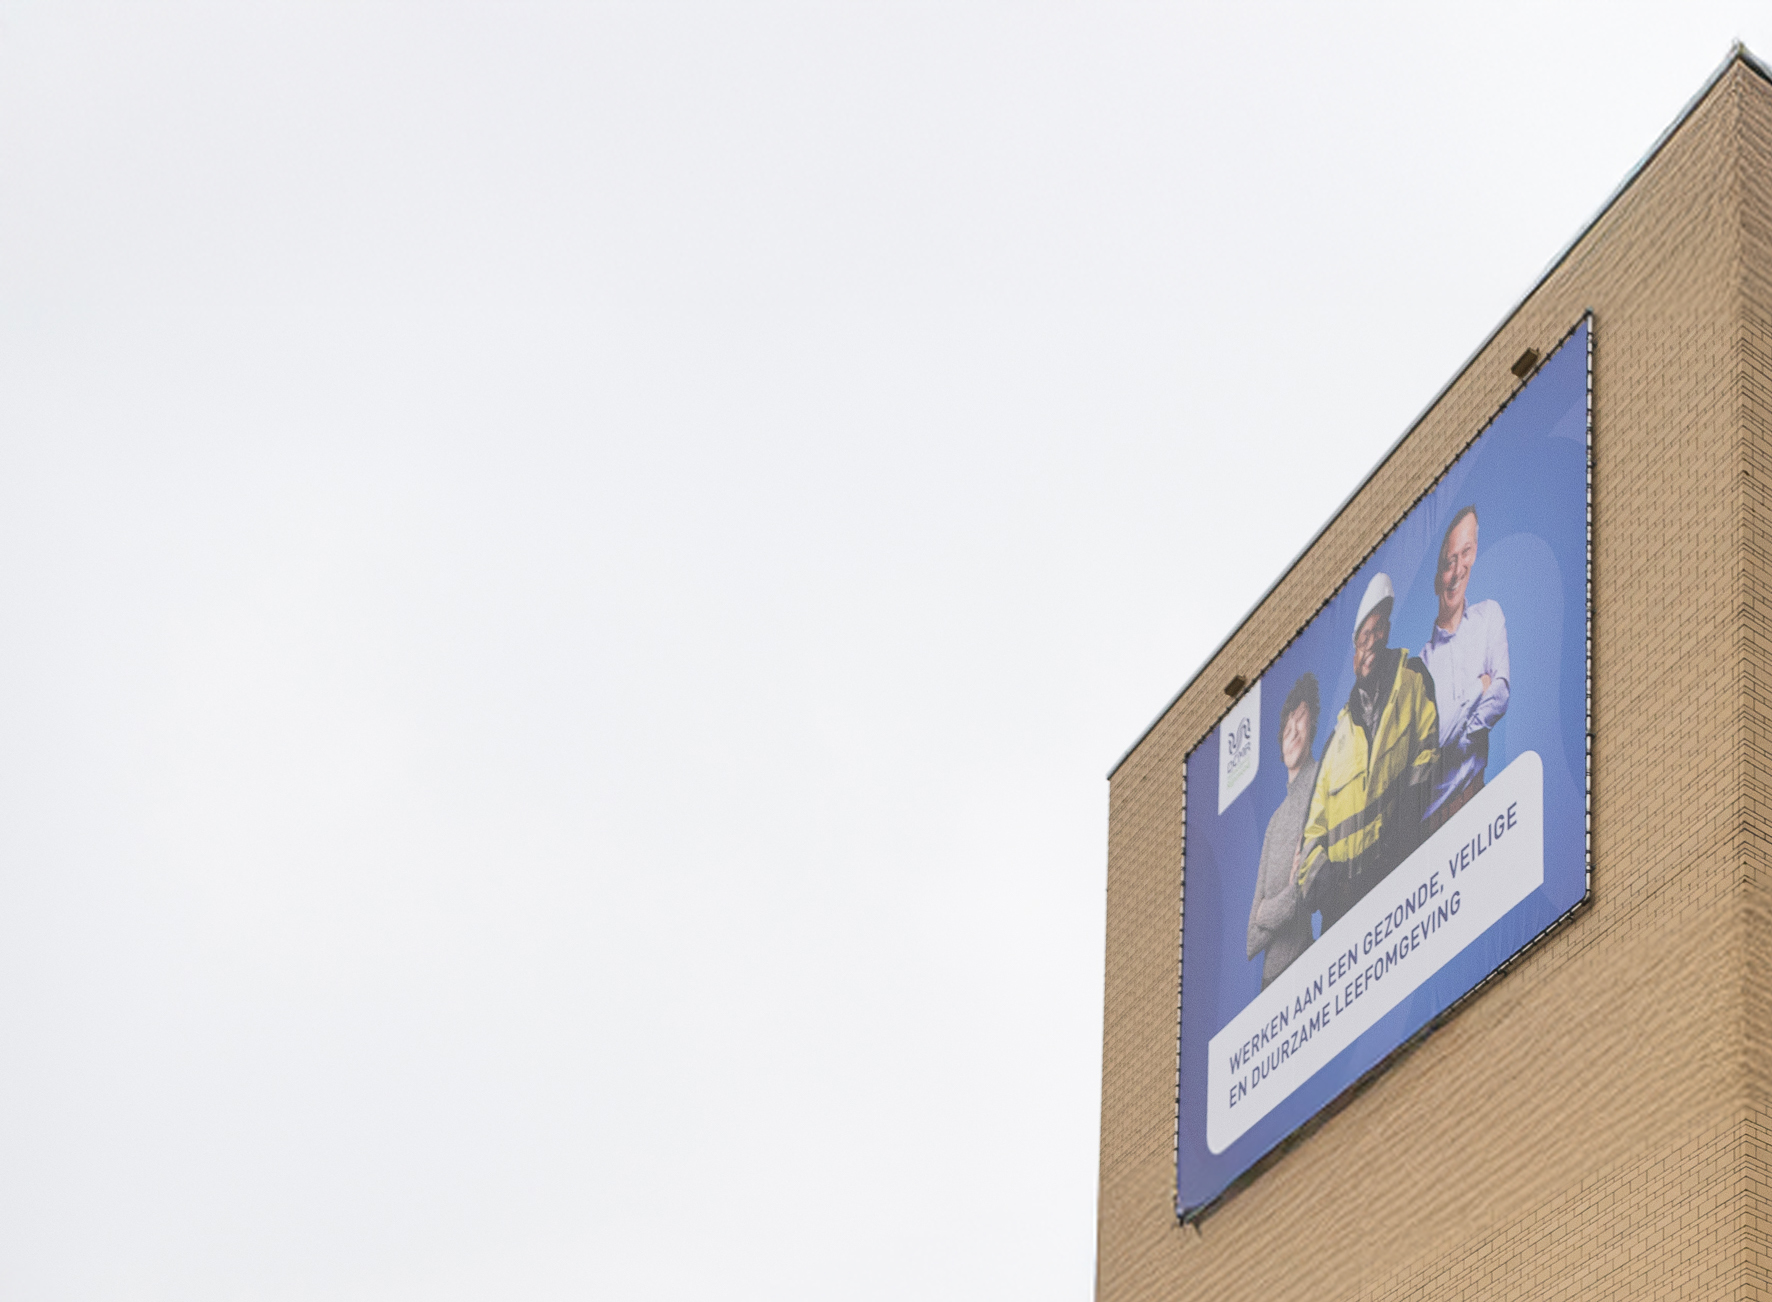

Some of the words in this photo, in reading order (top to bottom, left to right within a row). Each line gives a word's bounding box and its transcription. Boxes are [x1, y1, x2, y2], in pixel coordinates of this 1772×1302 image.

[1229, 1005, 1289, 1075] WERKEN
[1292, 973, 1323, 1020] AAN
[1328, 942, 1358, 988] EEN
[1363, 871, 1445, 955] GEZONDE,
[1448, 801, 1518, 879] VEILIGE
[1229, 1075, 1248, 1109] EN
[1251, 1002, 1331, 1090] DUURZAME
[1335, 890, 1461, 1016] LEEFOMGEVING
